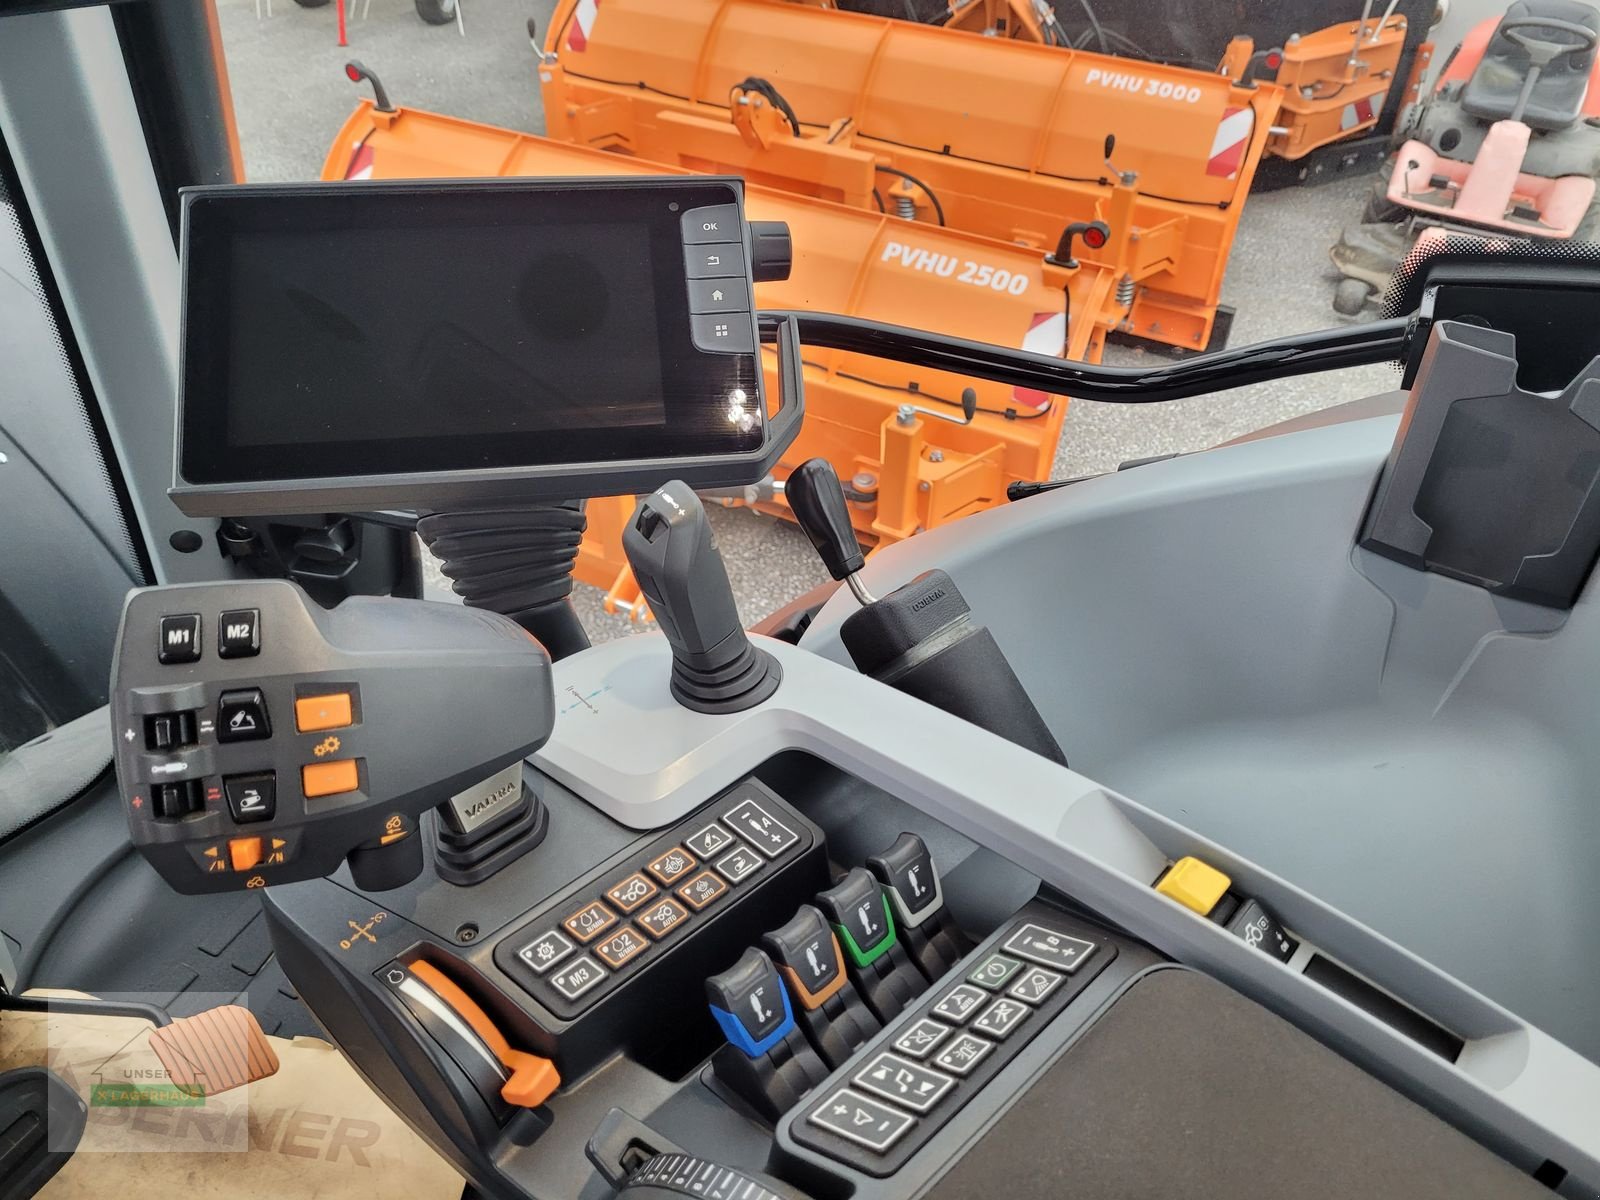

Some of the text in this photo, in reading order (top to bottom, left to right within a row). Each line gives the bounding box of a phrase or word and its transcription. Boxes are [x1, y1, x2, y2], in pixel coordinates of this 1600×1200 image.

[1085, 68, 1201, 104] PVHU 3000
[702, 222, 719, 231] OK
[880, 241, 1030, 296] PVHU 2500
[911, 588, 946, 612] WABCO
[168, 629, 190, 645] M1
[226, 623, 250, 639] M2
[464, 781, 517, 818] VALTRA
[761, 816, 773, 829] A
[700, 887, 716, 901] AUTO
[589, 908, 600, 920] 1
[662, 914, 678, 928] AUTO
[585, 918, 606, 934] N/MIN
[619, 934, 633, 947] 2
[617, 943, 637, 959] N/MIN
[568, 967, 590, 988] M3
[959, 996, 976, 1012] AUTO
